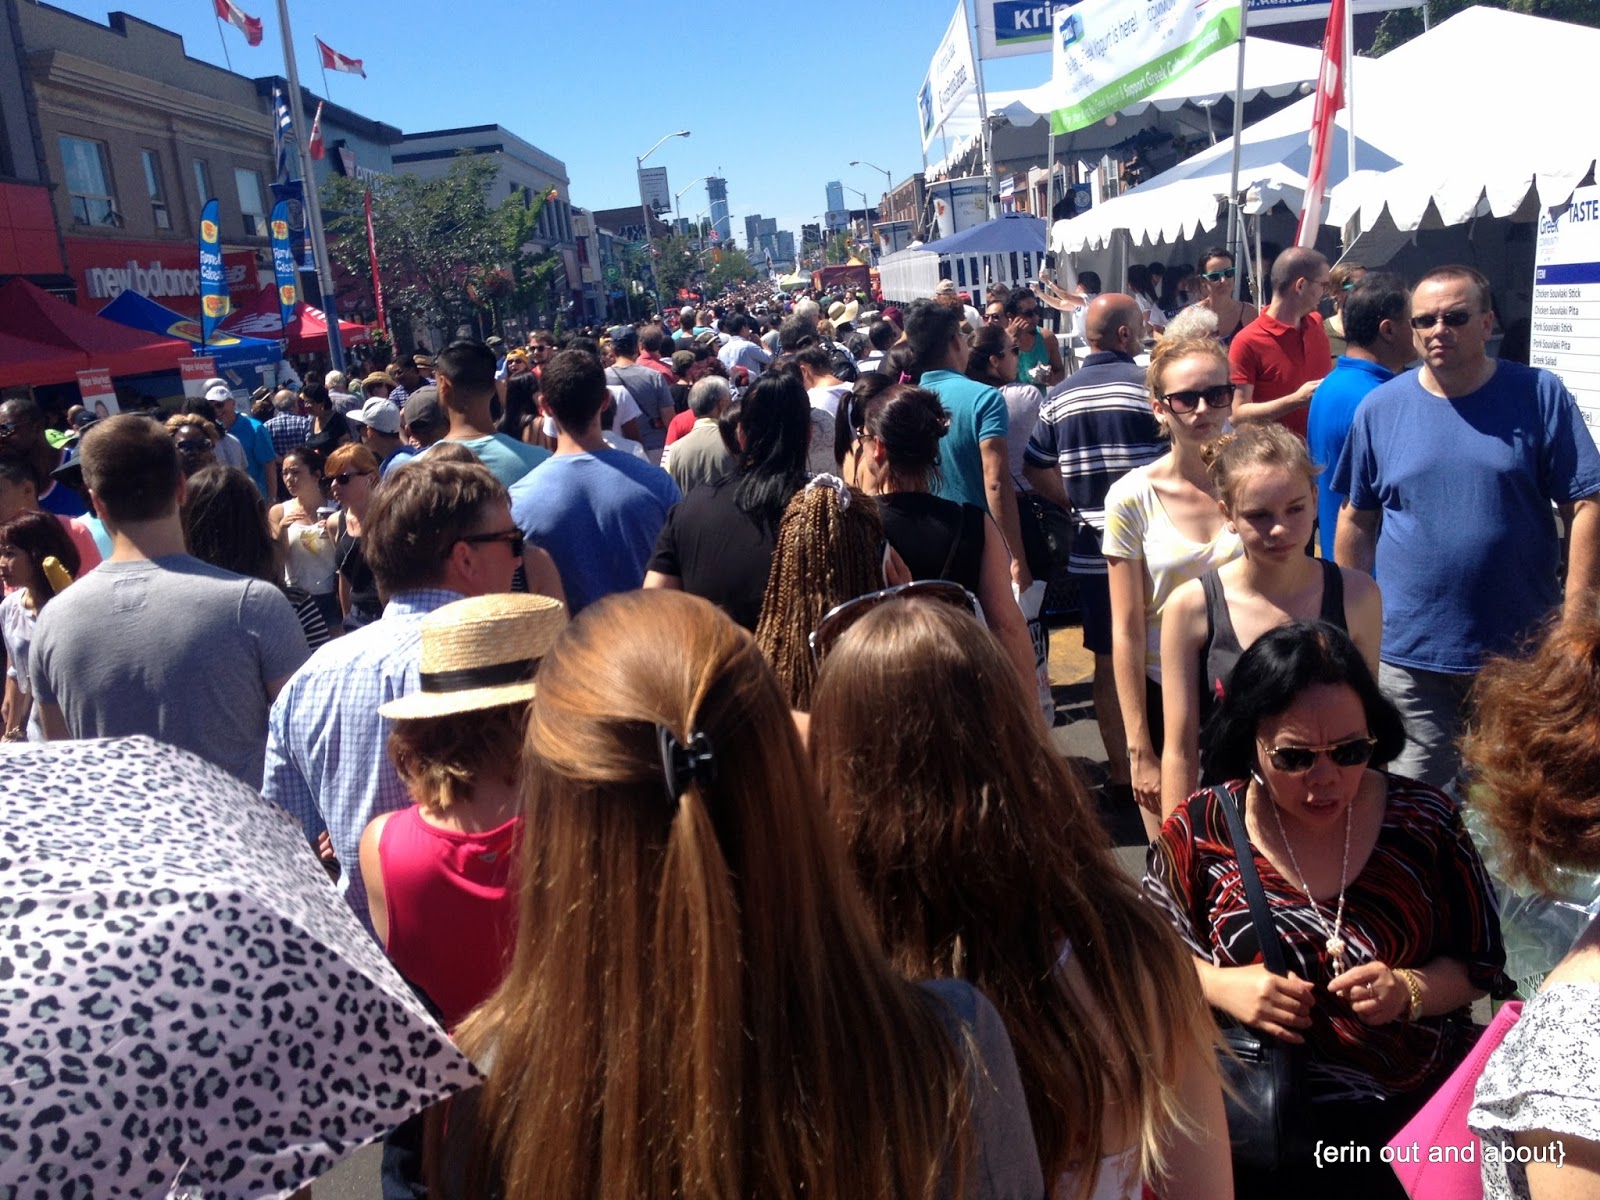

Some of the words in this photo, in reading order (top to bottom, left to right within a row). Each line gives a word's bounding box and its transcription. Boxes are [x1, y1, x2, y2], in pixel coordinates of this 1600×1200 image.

[1567, 199, 1599, 224] TASTE
[1568, 287, 1582, 299] Stick
[1568, 305, 1579, 316] Pita
[1561, 322, 1573, 333] Stick
[1561, 340, 1571, 351] Pita
[1532, 354, 1545, 365] Greek
[1544, 355, 1557, 366] Salad
